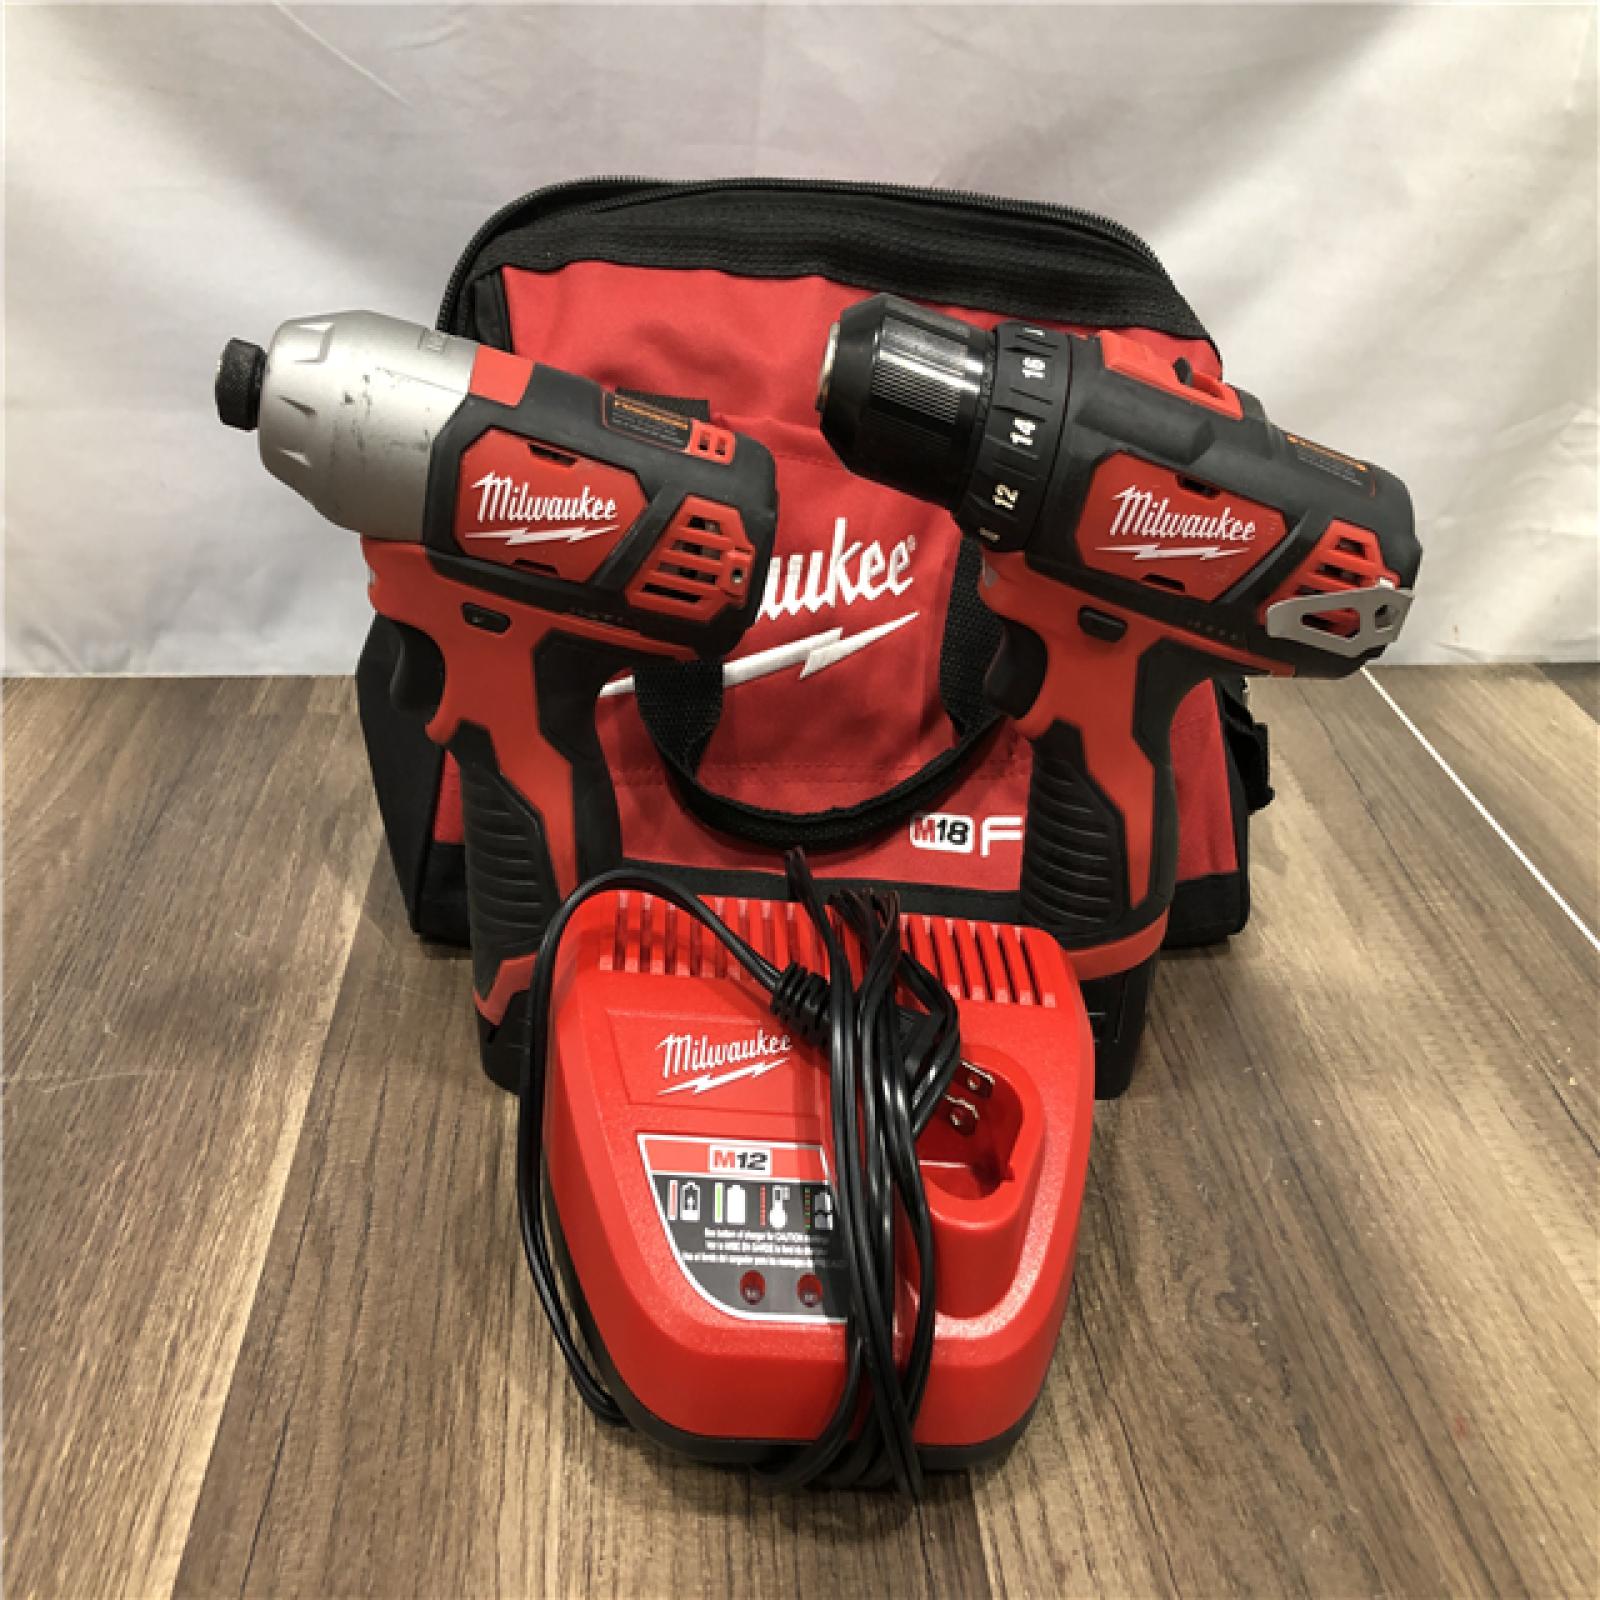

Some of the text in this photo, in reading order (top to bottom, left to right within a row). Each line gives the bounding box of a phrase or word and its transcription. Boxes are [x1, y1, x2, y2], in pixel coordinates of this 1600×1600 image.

[1009, 417, 1036, 446] 14
[471, 472, 616, 522] Milwaukee
[992, 484, 1018, 510] 12
[1109, 485, 1256, 542] Milwaukee
[911, 817, 971, 847] M18
[655, 1027, 792, 1079] Milwaukee
[713, 1150, 768, 1171] M12
